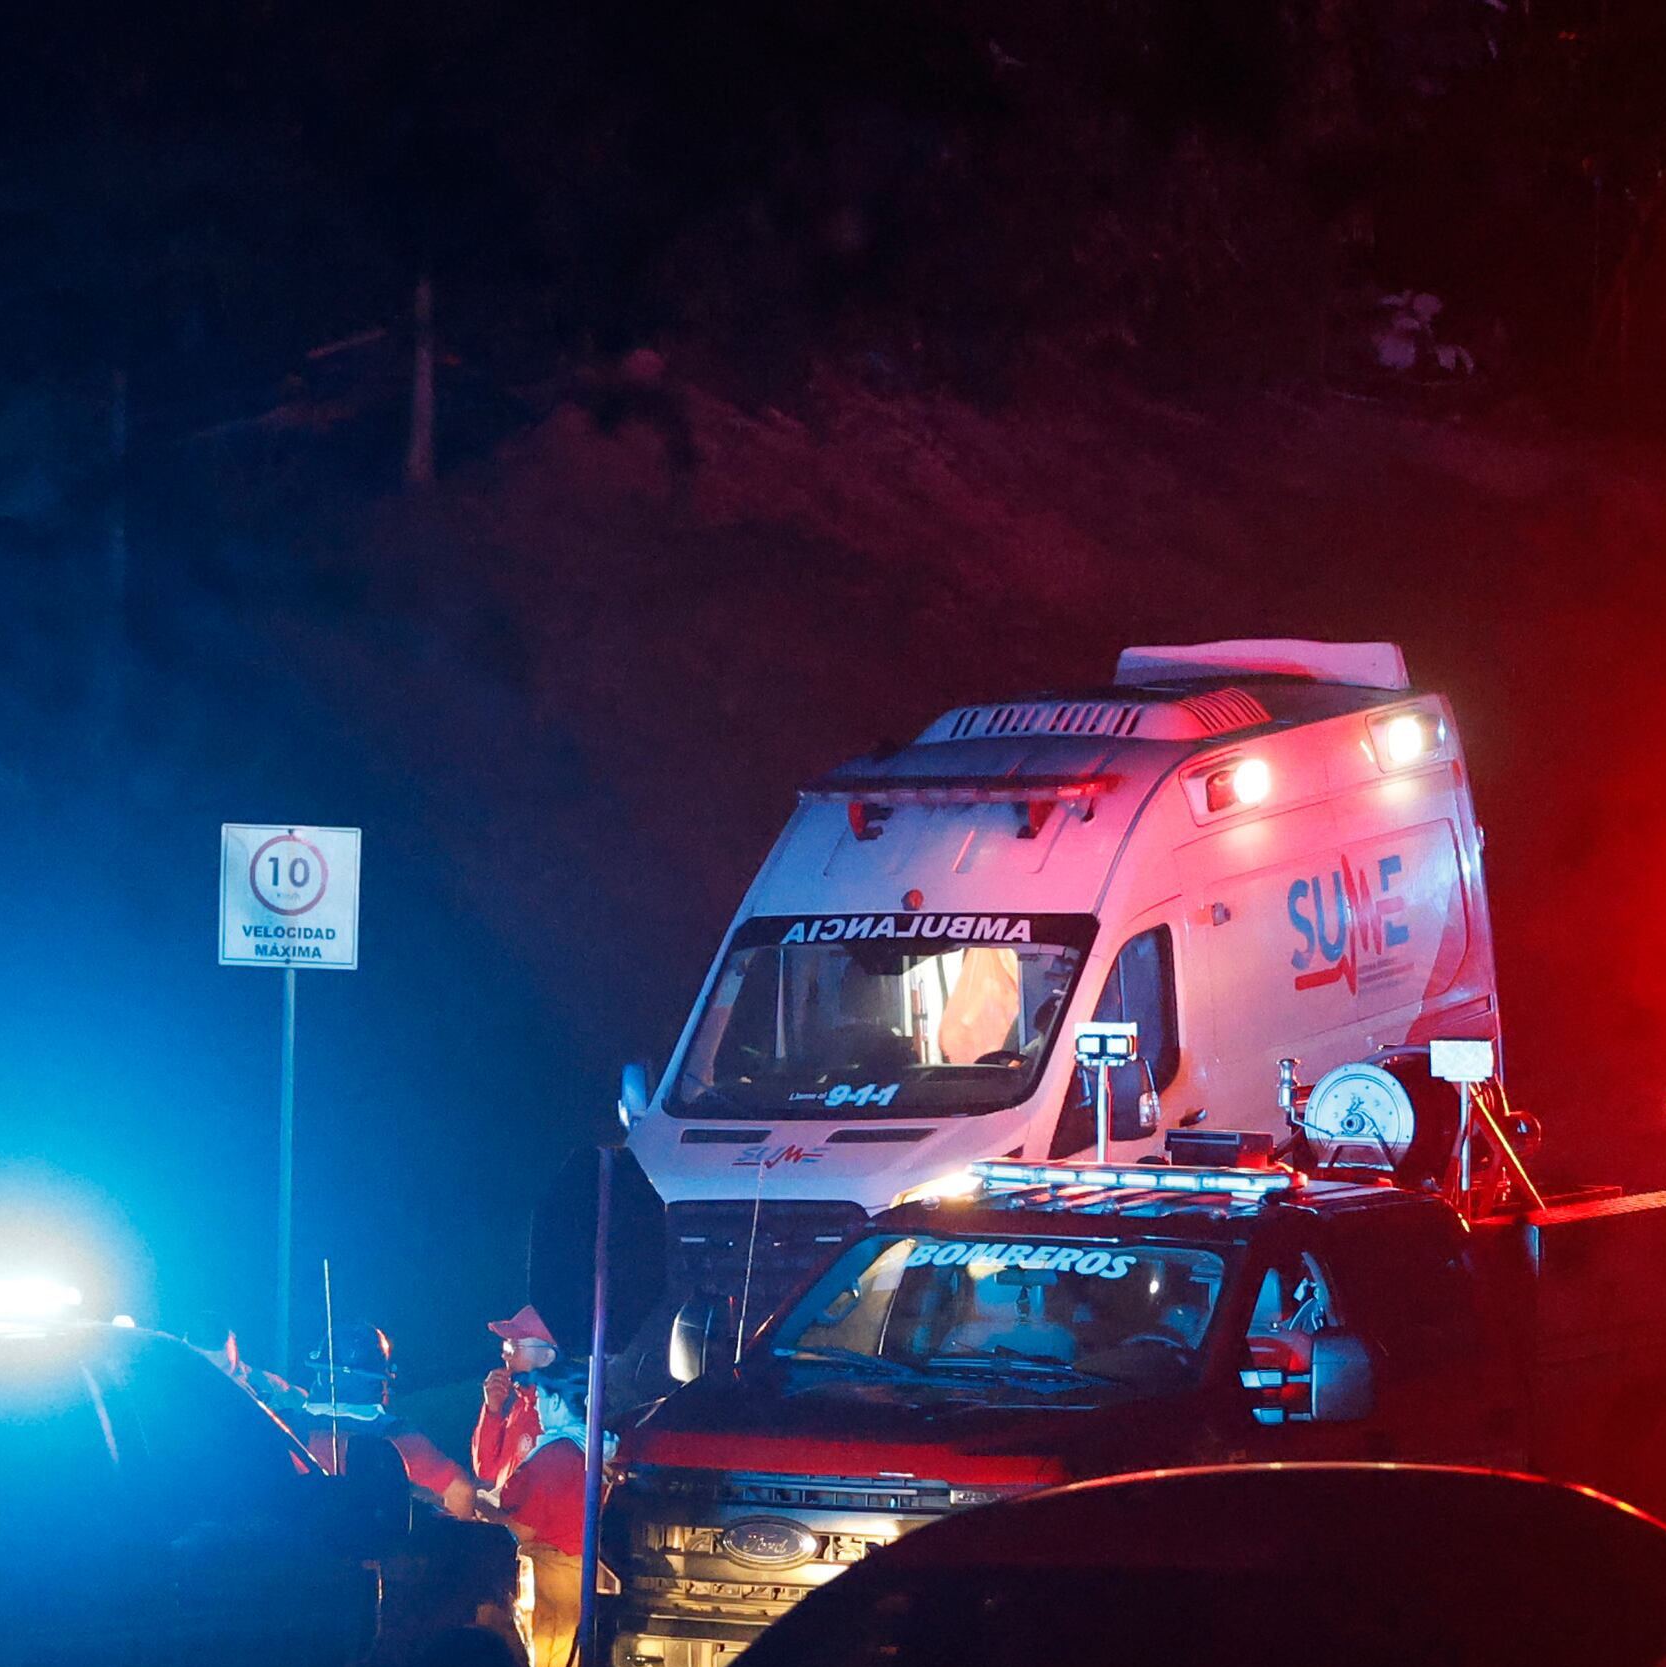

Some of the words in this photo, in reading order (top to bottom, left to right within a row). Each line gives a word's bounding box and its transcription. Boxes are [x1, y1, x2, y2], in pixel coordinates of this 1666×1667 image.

[267, 856, 311, 889] 10
[1288, 854, 1410, 975] SUME
[241, 924, 337, 941] VELOCIDAD
[254, 942, 323, 959] MÁXIMA
[905, 1243, 1138, 1280] BOMBEROS
